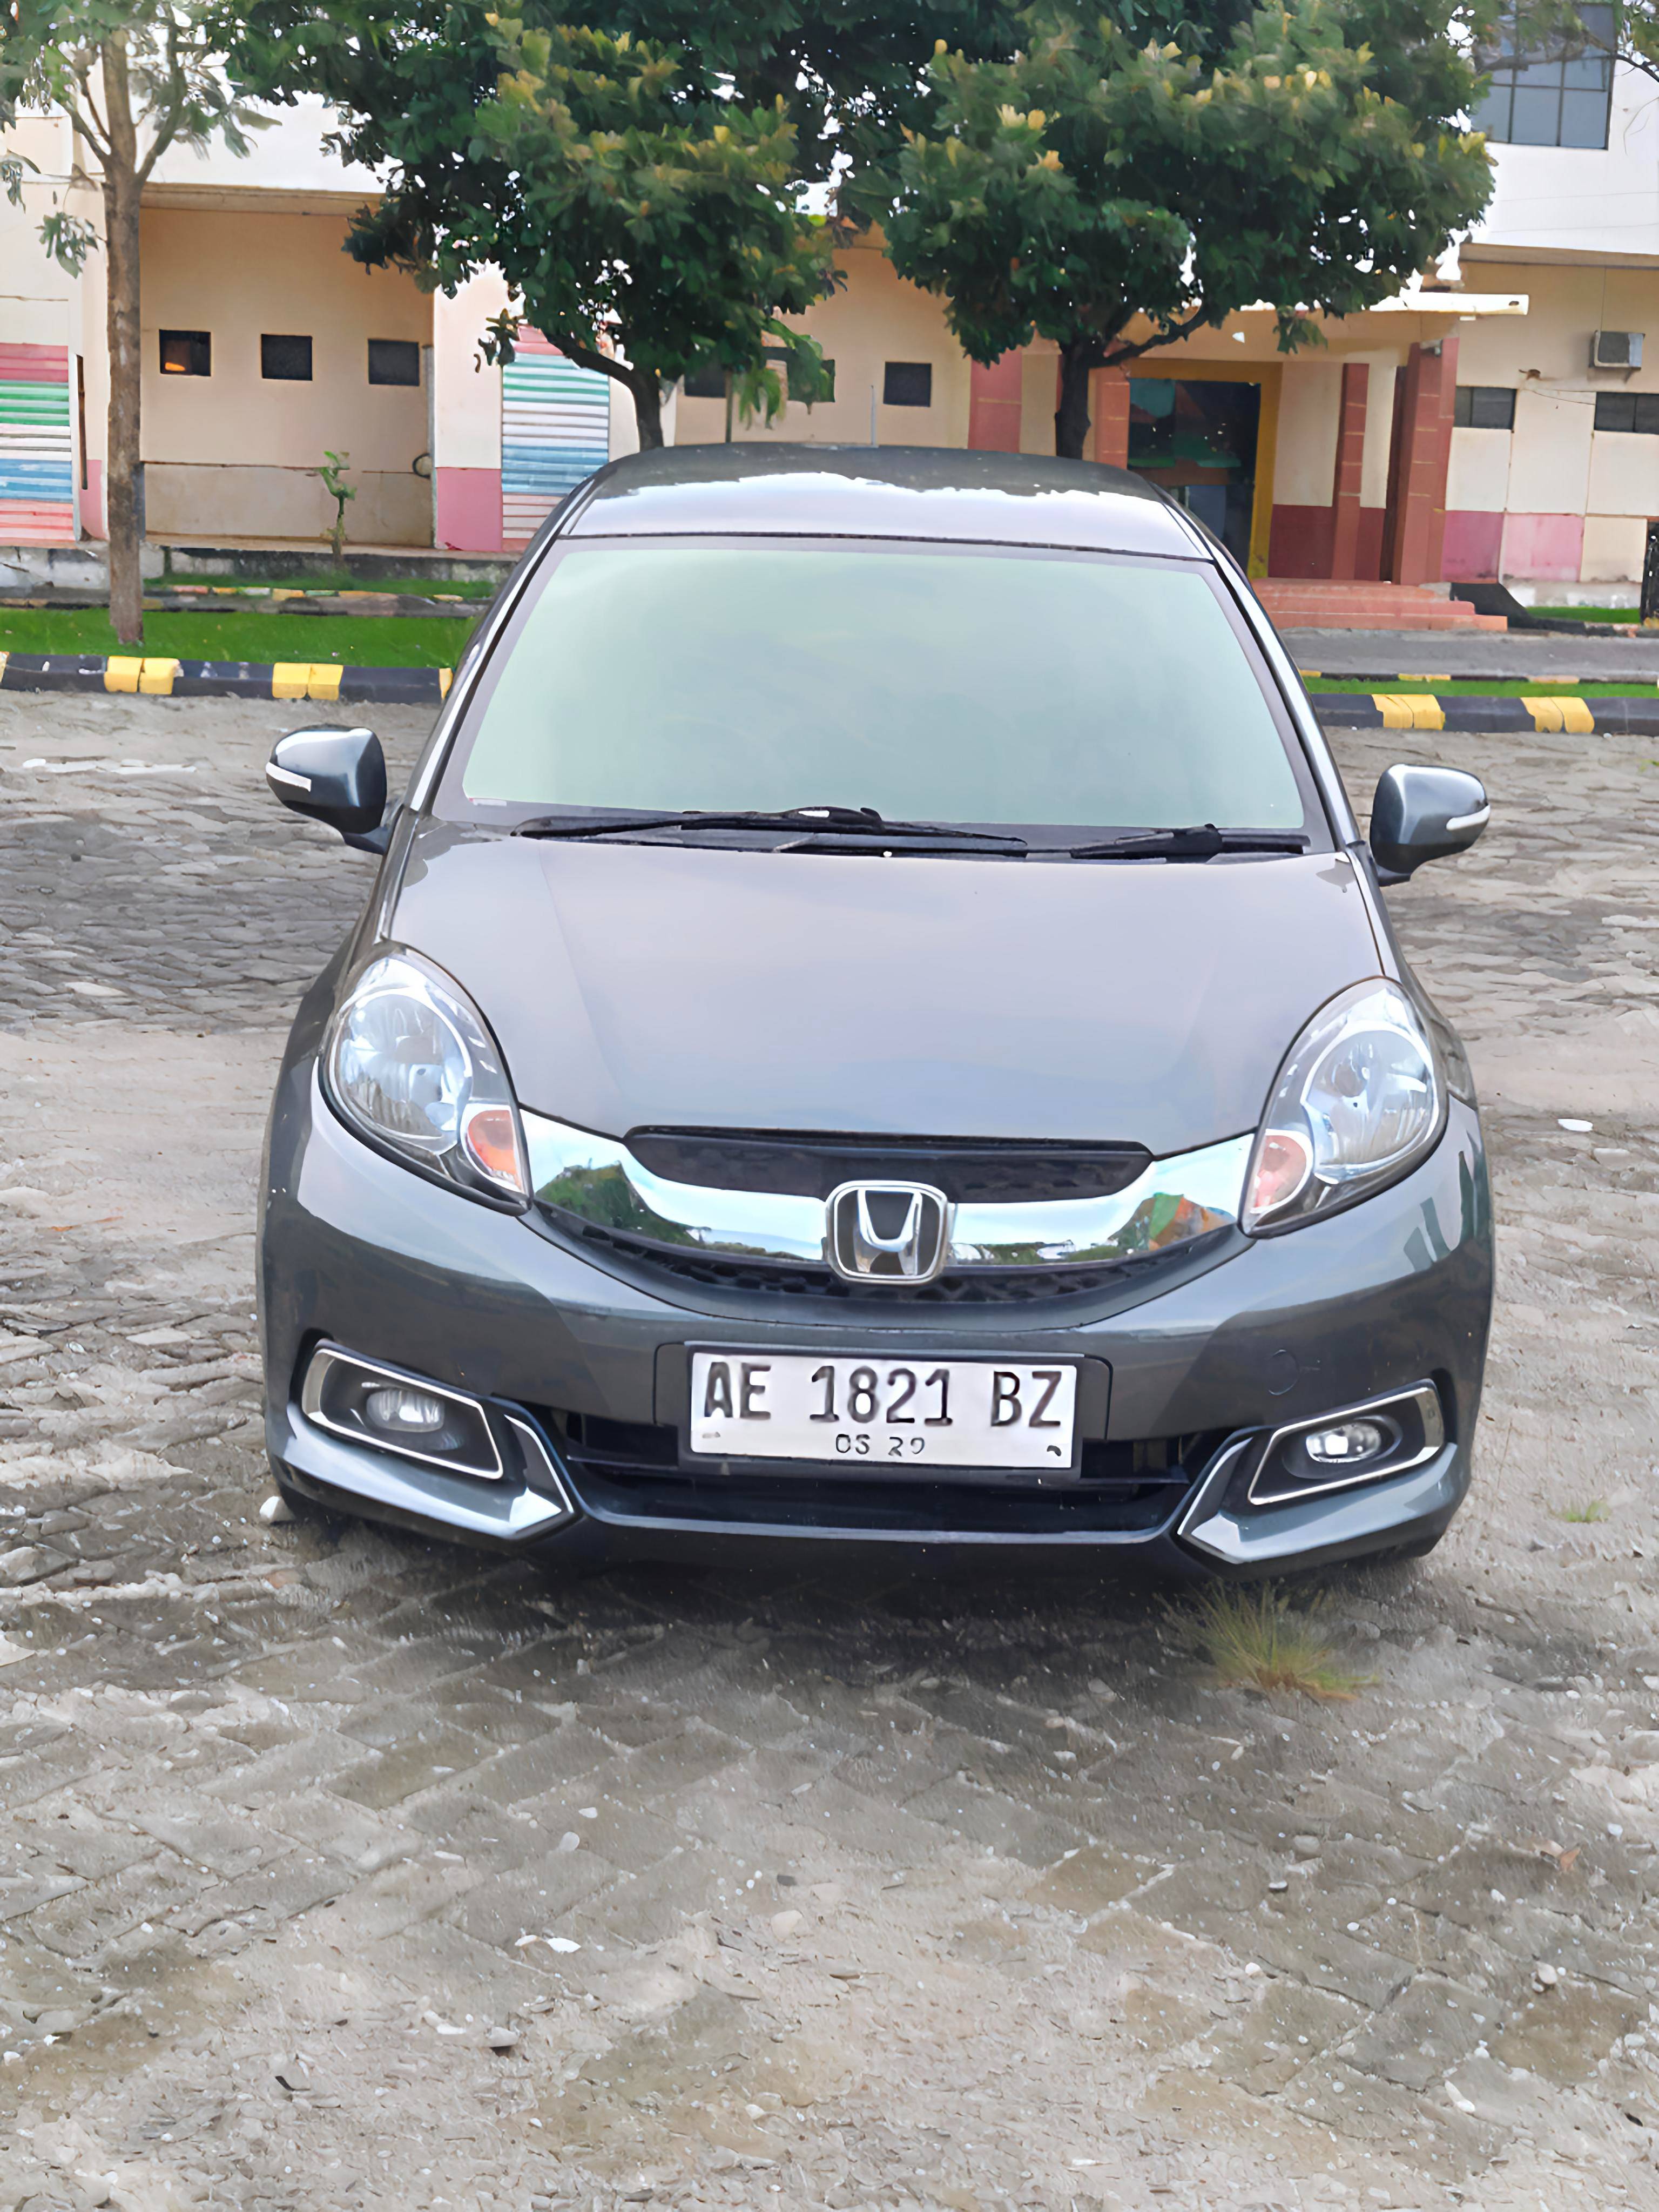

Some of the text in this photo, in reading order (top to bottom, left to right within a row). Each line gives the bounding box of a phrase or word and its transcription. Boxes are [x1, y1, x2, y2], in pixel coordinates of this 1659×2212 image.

[704, 1361, 1062, 1428] AE 1821 BZ
